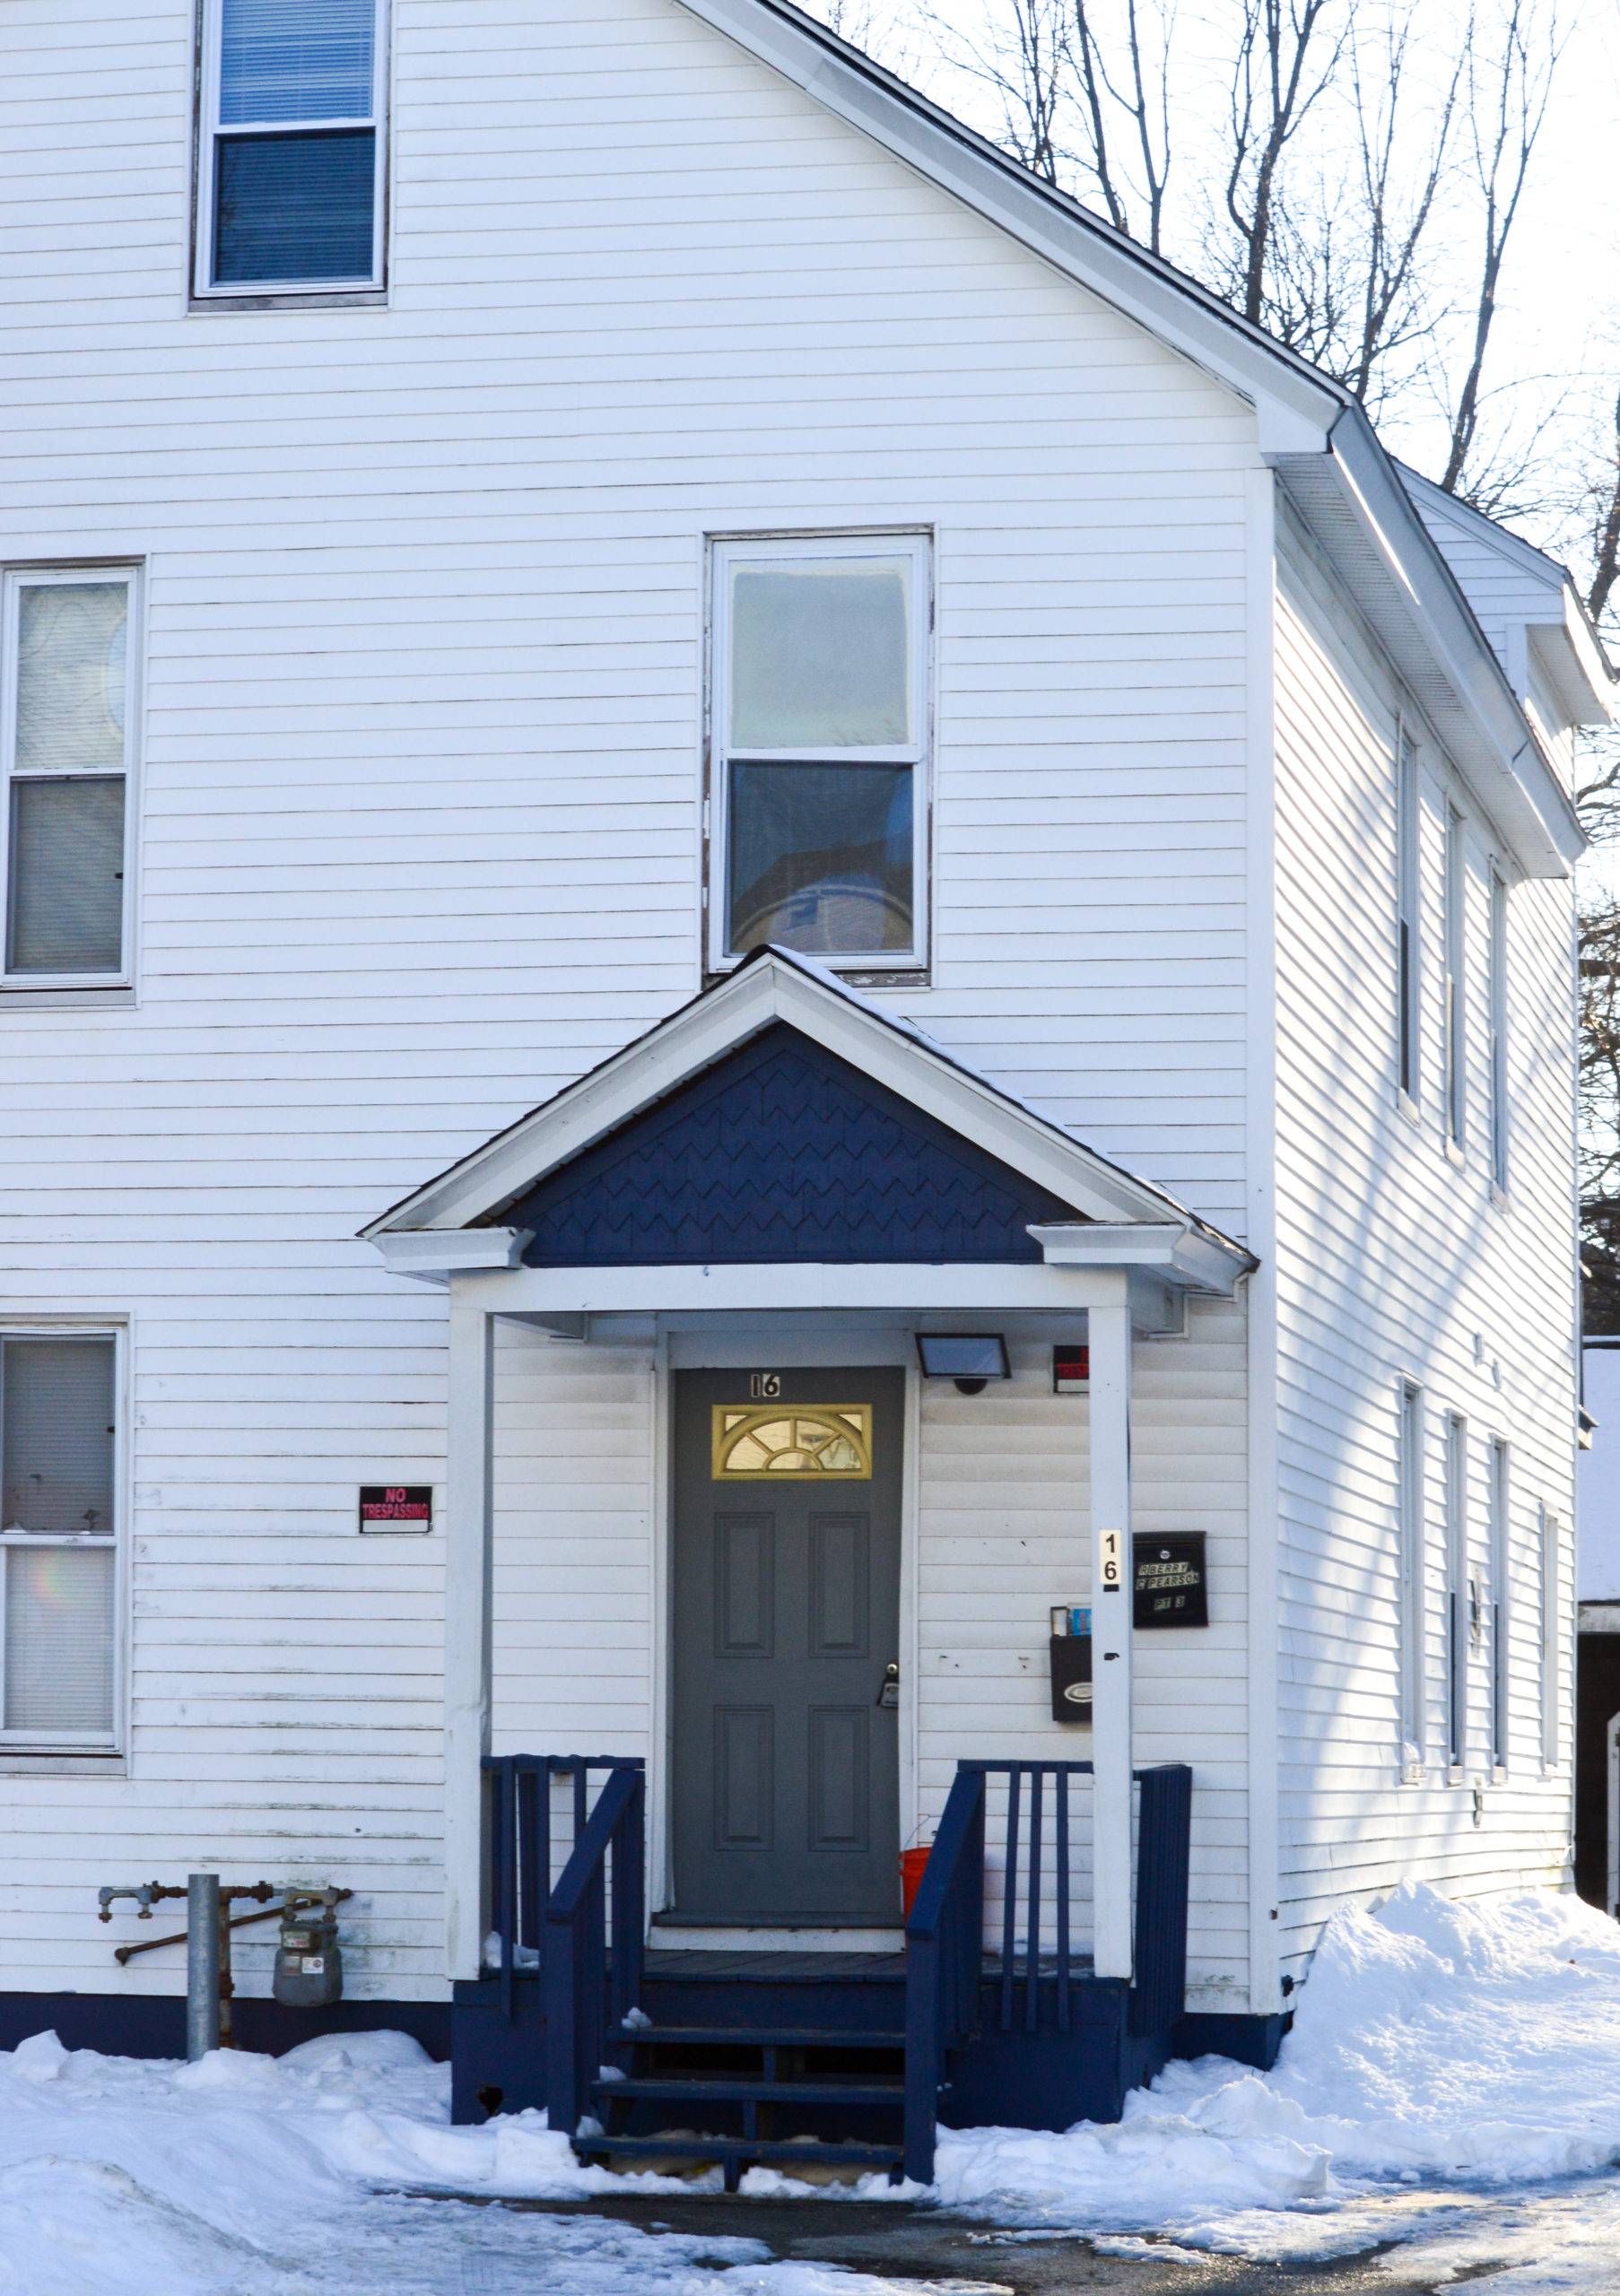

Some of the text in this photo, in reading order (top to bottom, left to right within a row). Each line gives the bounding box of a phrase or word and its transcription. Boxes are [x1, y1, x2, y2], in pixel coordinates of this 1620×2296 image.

[752, 1374, 780, 1397] 16
[385, 1487, 405, 1503] NO
[362, 1503, 429, 1519] TRESPASSING
[1148, 1572, 1199, 1587] PEARSON
